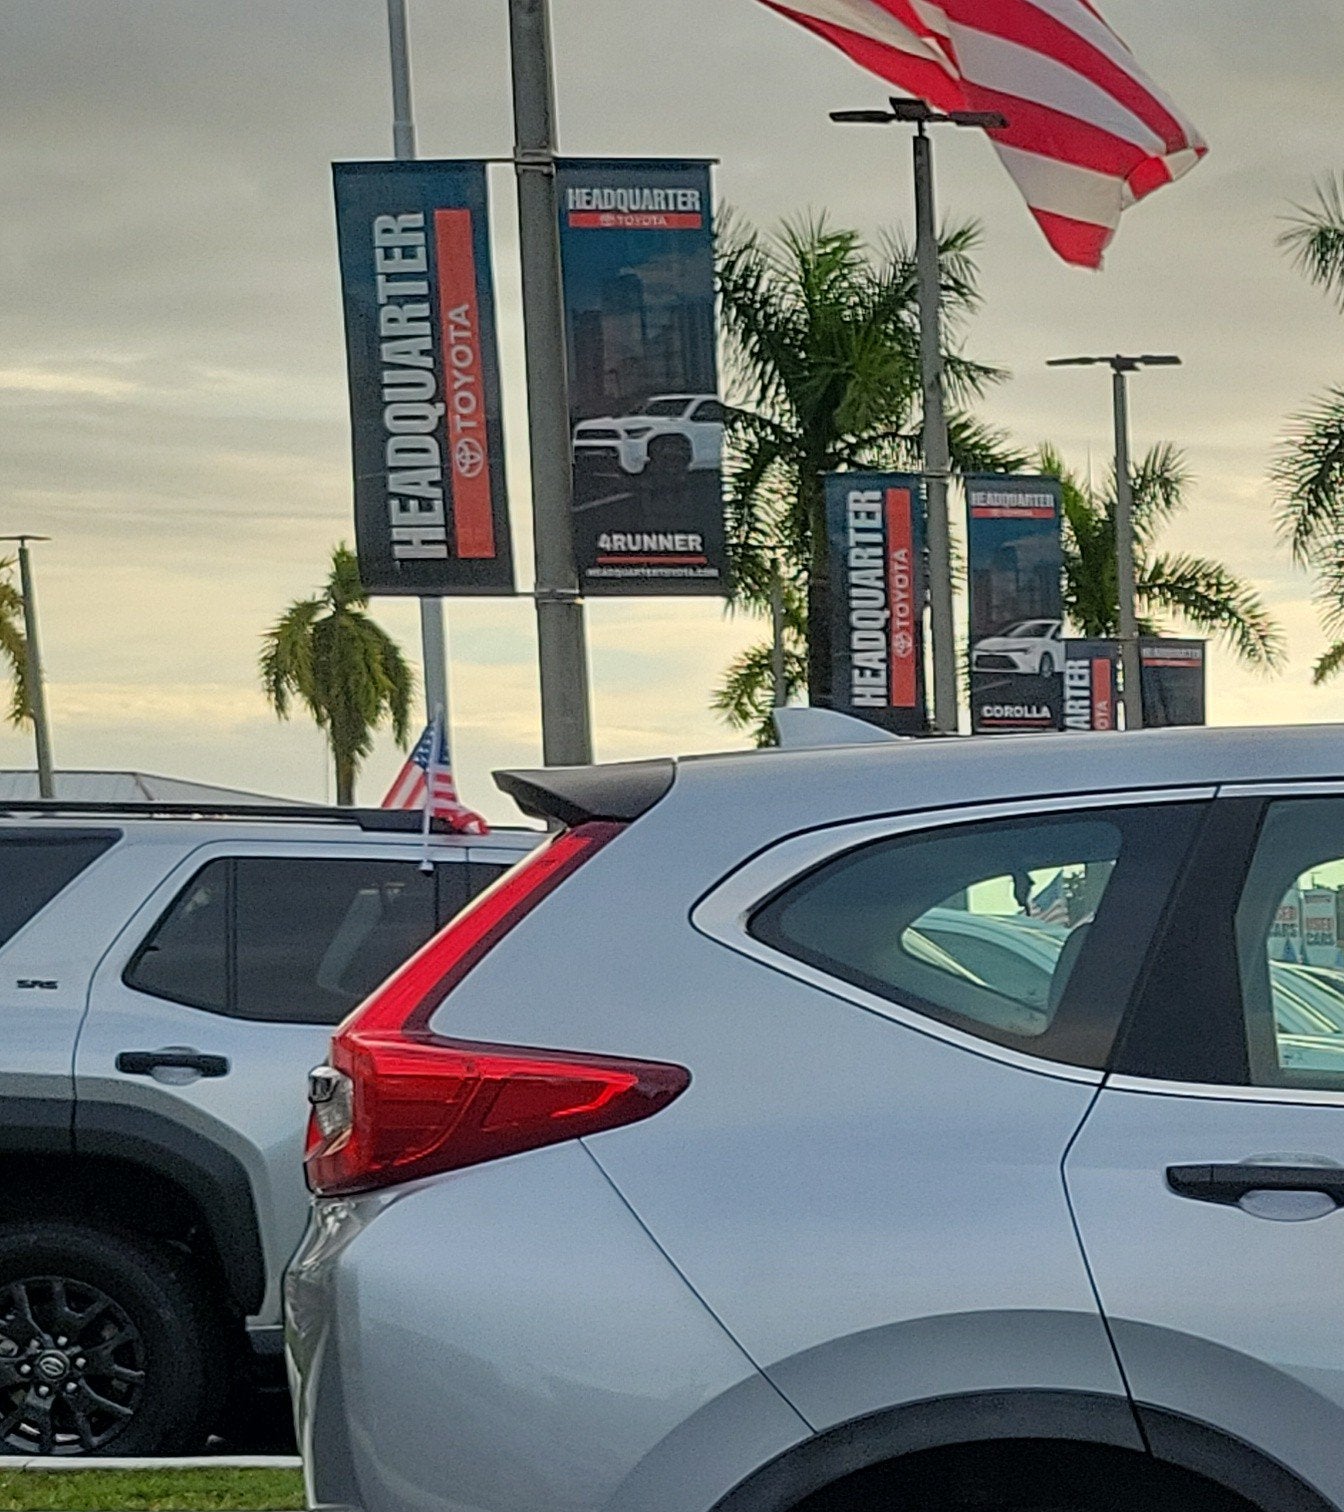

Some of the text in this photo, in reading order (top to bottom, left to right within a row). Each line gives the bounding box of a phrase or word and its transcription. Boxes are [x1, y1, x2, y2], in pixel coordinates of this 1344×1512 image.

[568, 188, 700, 213] HEADQUARTER
[617, 215, 668, 227] TOYOTA
[373, 210, 449, 562] HEADQUARTER
[448, 303, 479, 433] TOYOTA
[598, 532, 704, 552] 4RUNNER
[847, 489, 890, 708] HEADQUARTER
[892, 547, 910, 628] TOYOTA
[981, 704, 1051, 719] COROLLA
